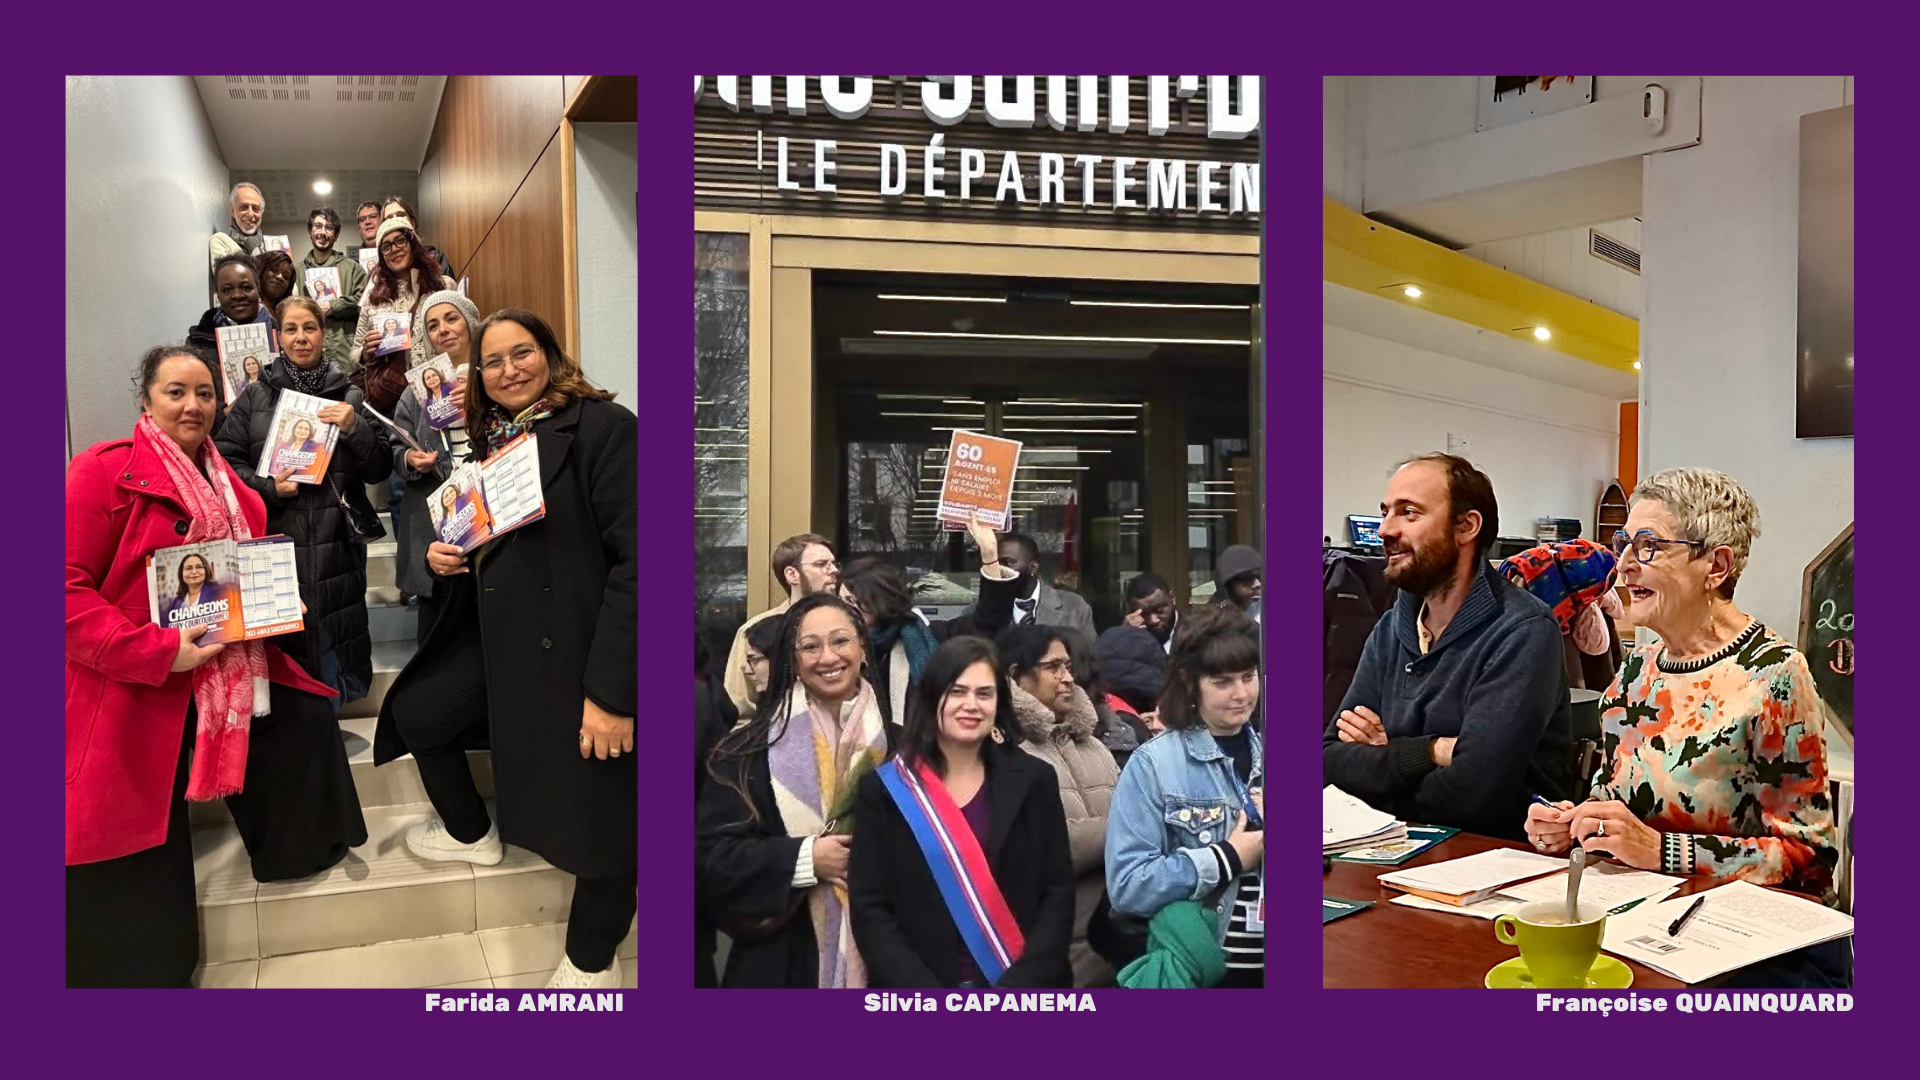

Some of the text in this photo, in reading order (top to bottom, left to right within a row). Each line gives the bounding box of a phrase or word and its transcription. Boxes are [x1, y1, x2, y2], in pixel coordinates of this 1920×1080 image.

[778, 133, 1260, 215] LE DÉPARTEMEN
[278, 448, 318, 460] CHANGEONS
[956, 443, 982, 461] 60
[441, 500, 476, 536] CHANGEONS
[168, 598, 229, 622] CHANGEONS
[271, 622, 300, 633] CHANGEONS
